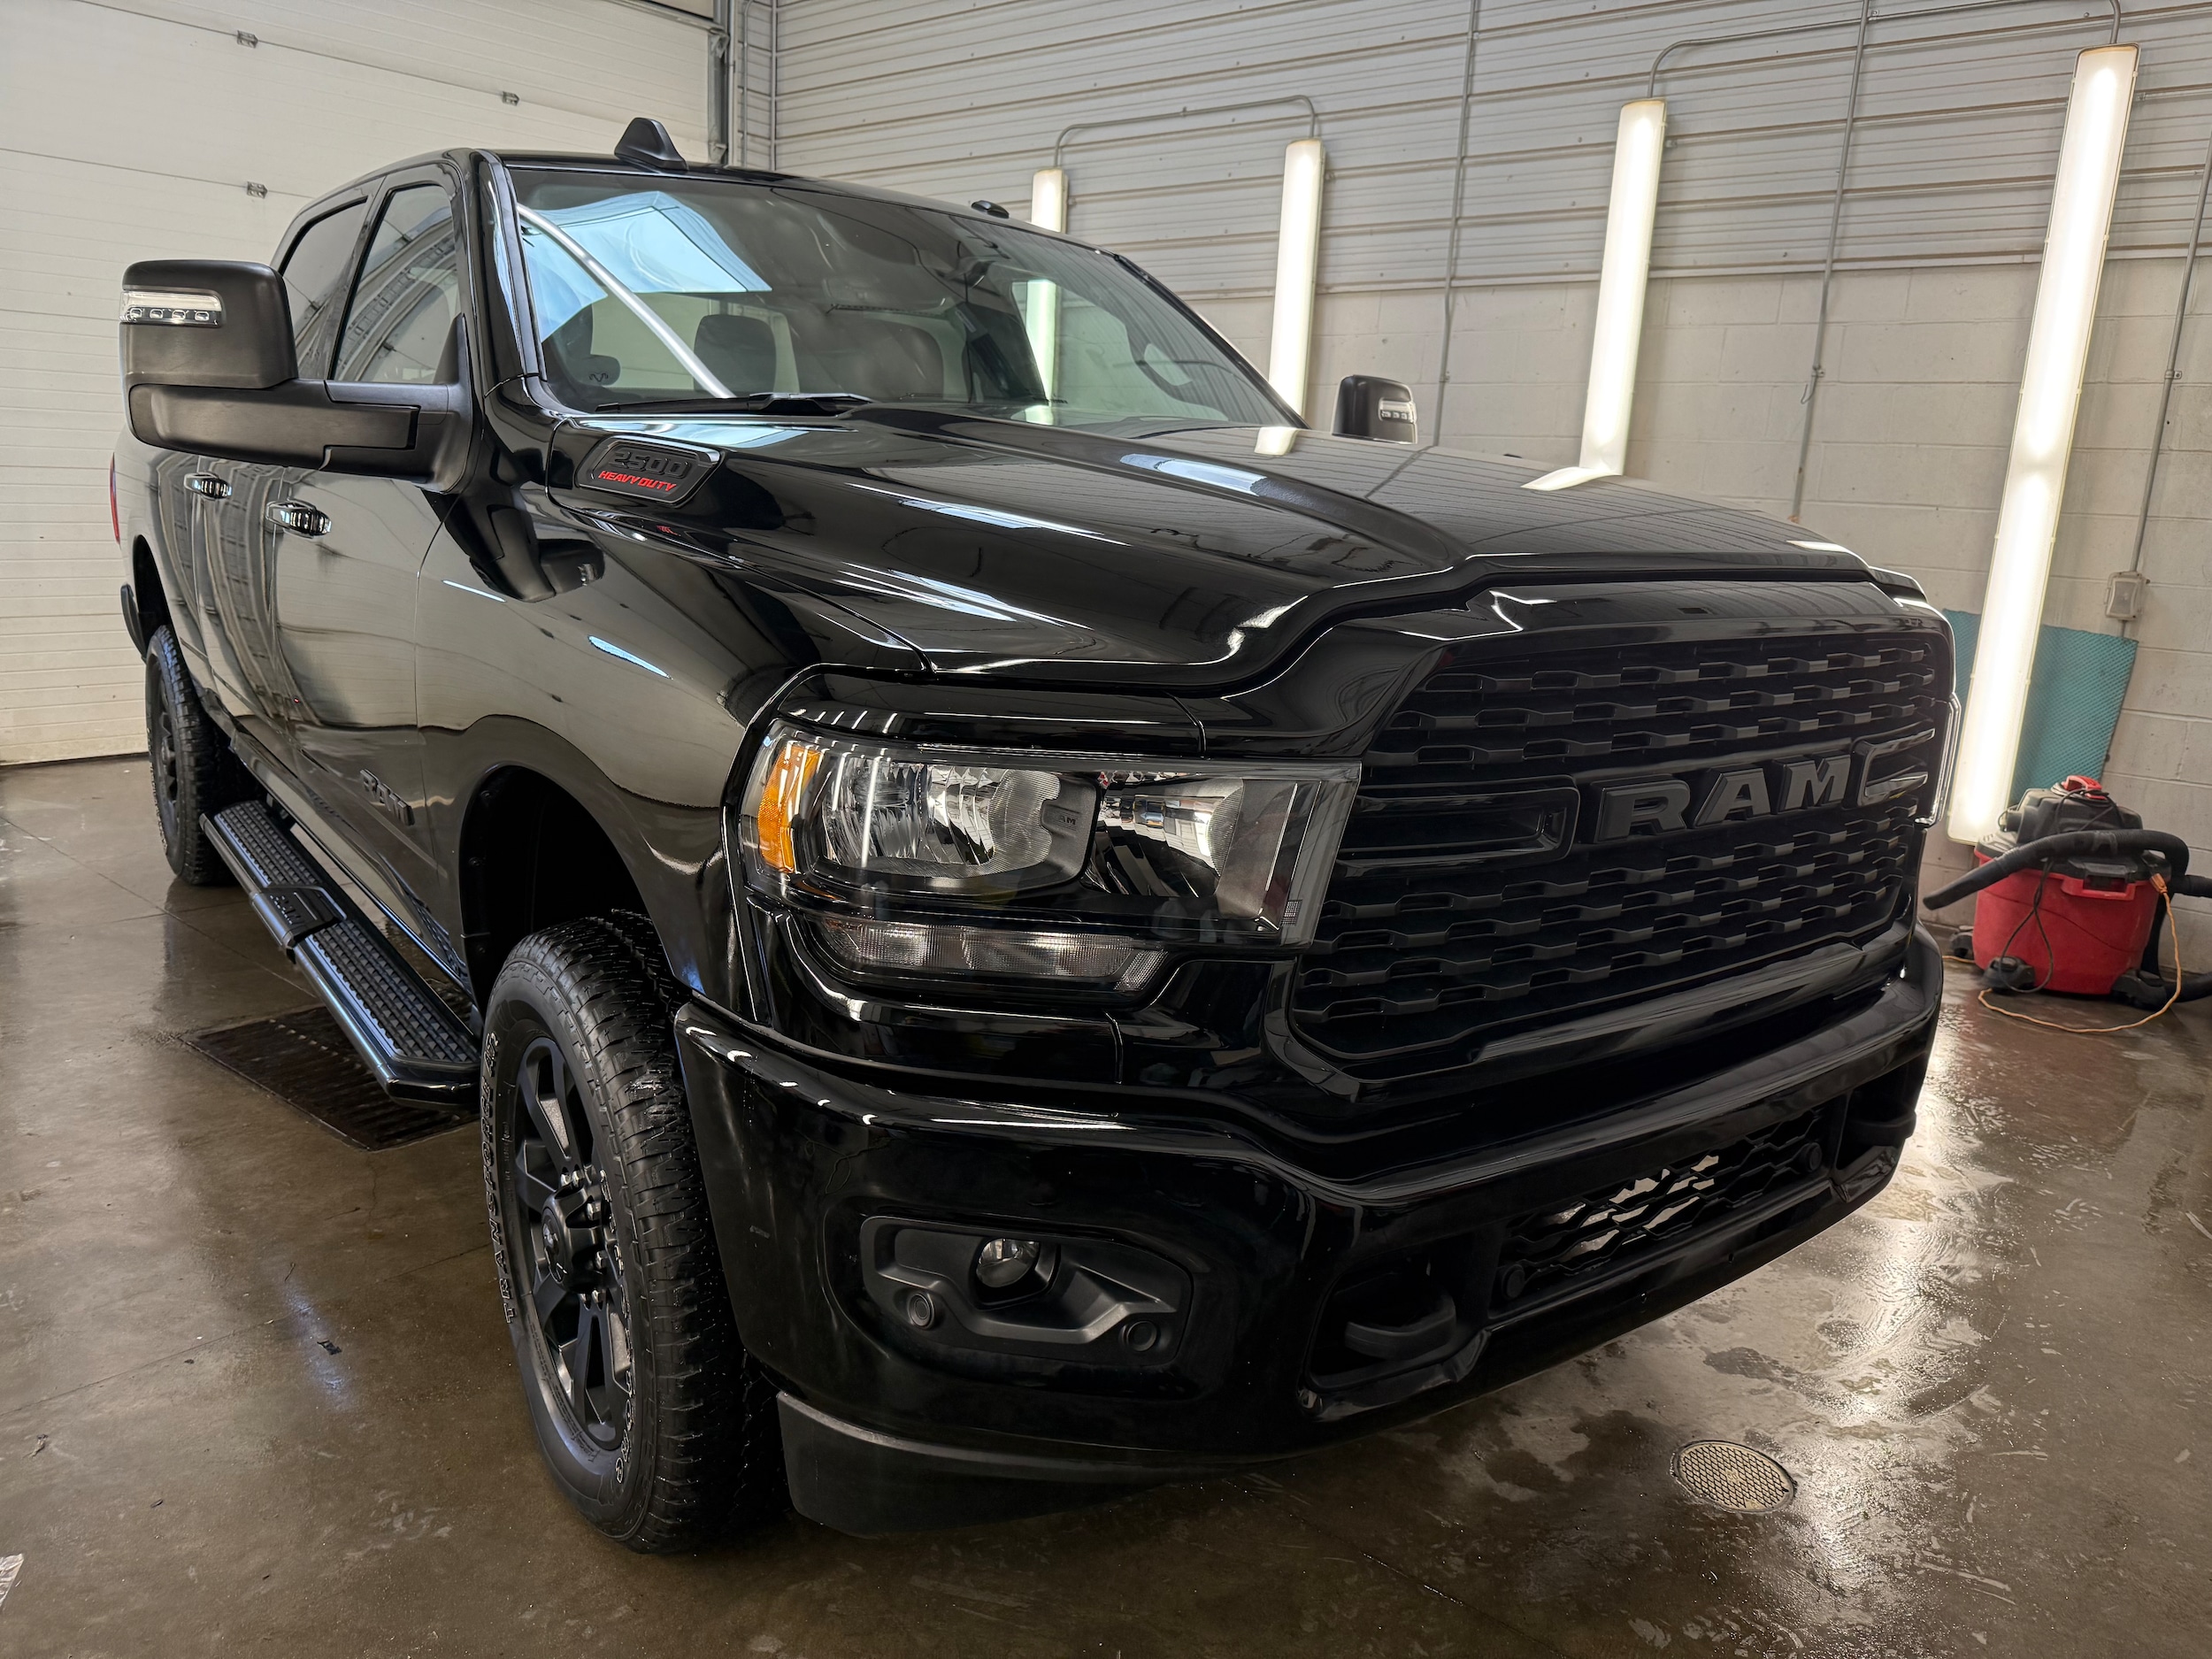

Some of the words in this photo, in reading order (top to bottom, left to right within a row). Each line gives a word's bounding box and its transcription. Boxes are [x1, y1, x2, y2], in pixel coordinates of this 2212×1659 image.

[608, 450, 691, 479] 2500
[598, 470, 640, 484] HEAVY
[639, 477, 677, 492] DUTY
[1592, 750, 1851, 844] RAM
